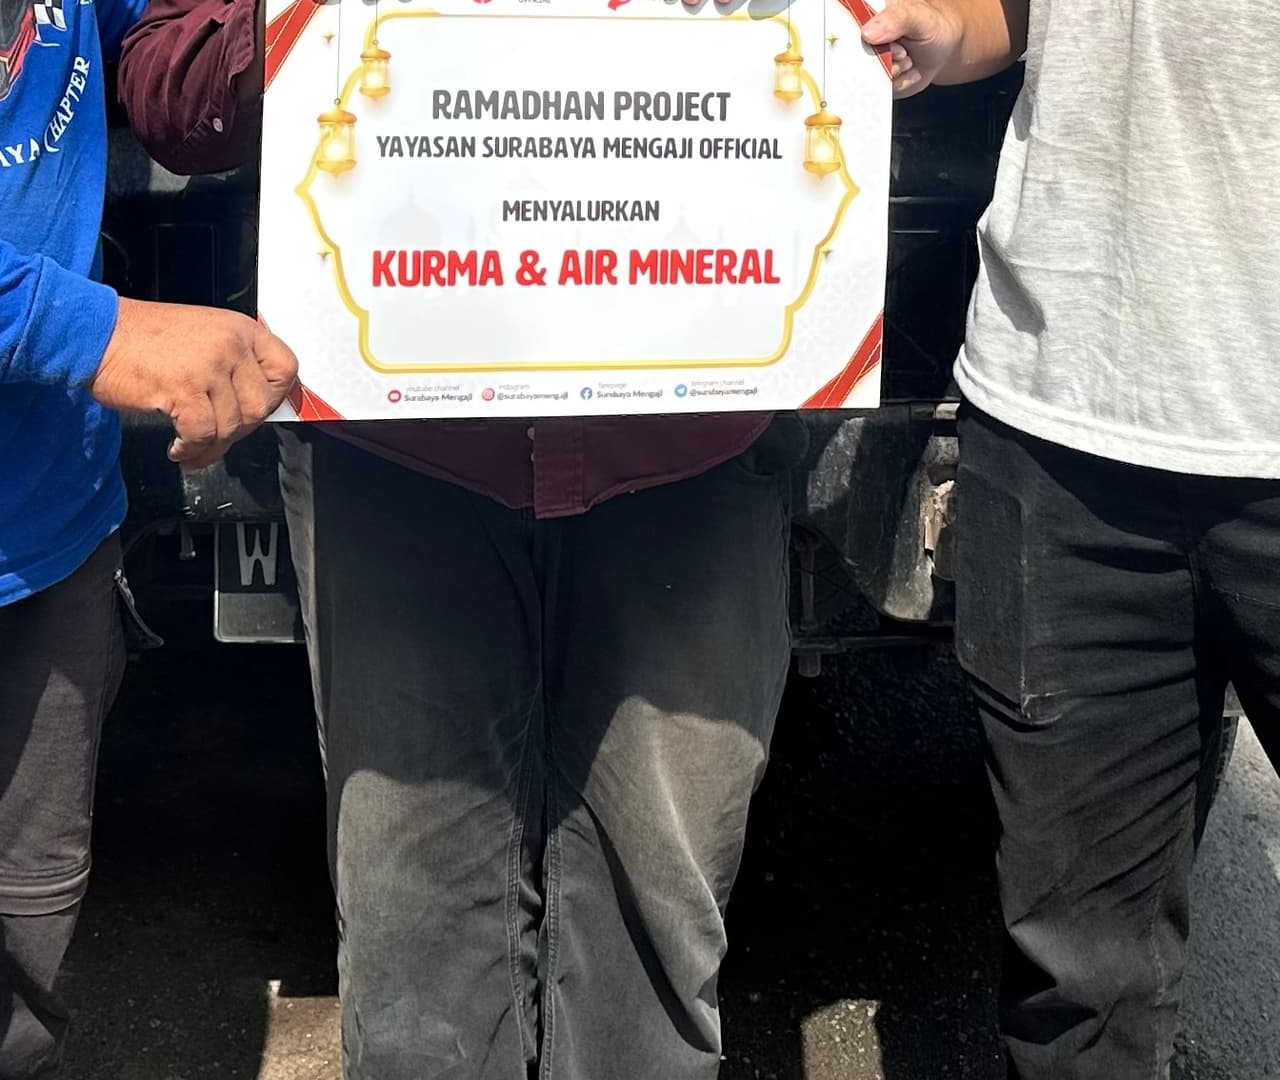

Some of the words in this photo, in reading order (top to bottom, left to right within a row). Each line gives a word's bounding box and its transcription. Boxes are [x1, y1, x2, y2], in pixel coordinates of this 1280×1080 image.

[44, 56, 91, 153] CHAPTER
[432, 89, 605, 121] RAMADHAN
[613, 91, 731, 122] PROJECT
[376, 135, 476, 159] YAYASAN
[482, 136, 597, 159] SURABAYA
[603, 137, 693, 160] MENGAJI
[699, 137, 783, 160] OFFICIAL
[502, 200, 660, 222] MENYALURKAN
[372, 249, 504, 287] KURMA
[515, 250, 547, 287] &
[557, 249, 618, 286] AIR
[628, 249, 781, 285] MINERAL
[404, 393, 440, 402] Surabaya
[441, 393, 472, 402] Mengaji
[597, 390, 632, 399] Surabaya
[632, 389, 664, 399] Mengaji
[236, 521, 278, 586] W
